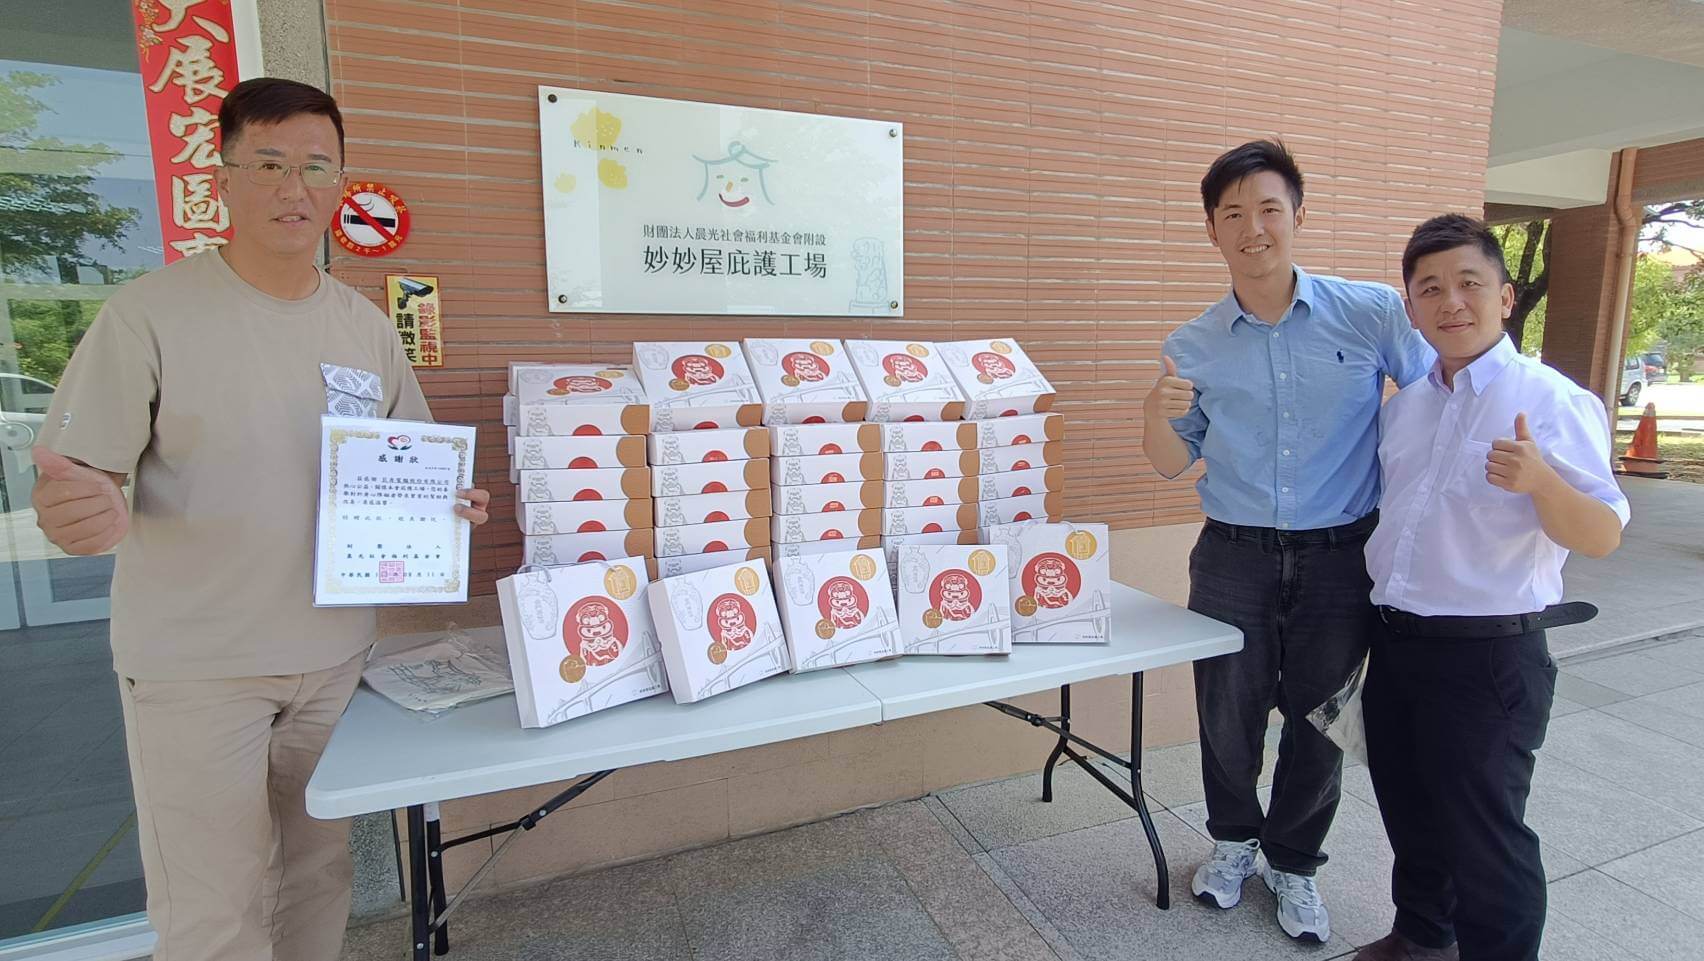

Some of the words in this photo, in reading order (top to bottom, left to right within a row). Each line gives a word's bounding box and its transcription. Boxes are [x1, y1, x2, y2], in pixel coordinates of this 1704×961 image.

[148, 0, 231, 257] 大展宏圖
[573, 139, 644, 154] Kinmen
[642, 224, 827, 246] 財團法人晨光社會福利基金會附設
[643, 245, 827, 279] 妙妙屋庇護工場
[417, 302, 438, 365] 錄影監視中
[378, 454, 419, 464] 感謝狀
